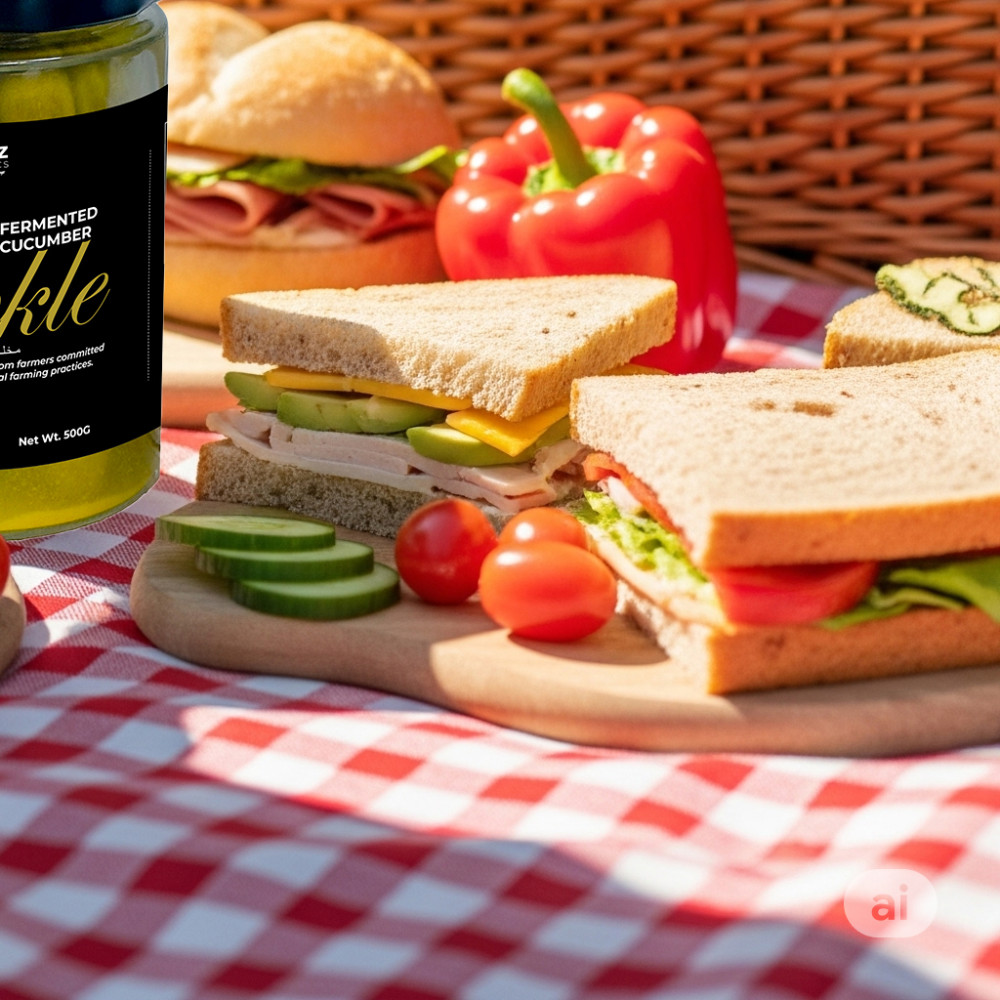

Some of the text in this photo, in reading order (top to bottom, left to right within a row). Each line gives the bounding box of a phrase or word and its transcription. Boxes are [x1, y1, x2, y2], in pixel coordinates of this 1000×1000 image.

[0, 206, 98, 235] FERMENTED
[0, 225, 92, 253] CUCUMBER
[16, 356, 55, 369] farmers
[56, 342, 106, 363] committed
[9, 369, 49, 381] farming
[50, 359, 94, 378] practices.
[18, 424, 91, 447] Net Wt. 500G
